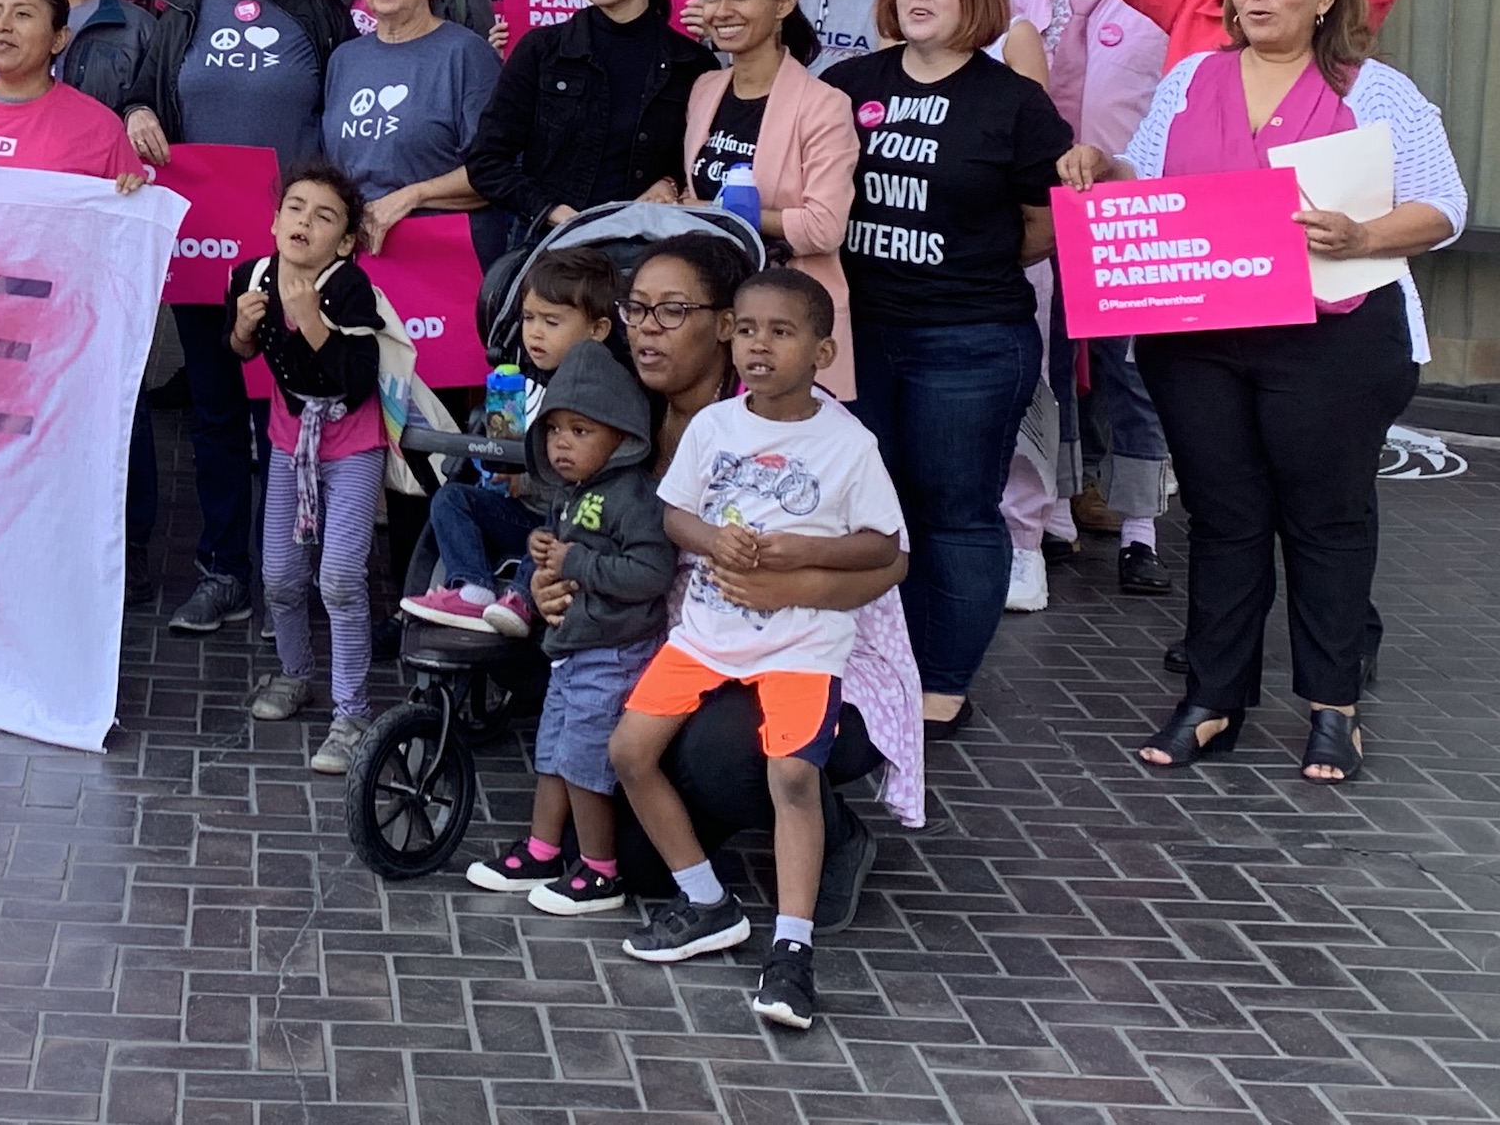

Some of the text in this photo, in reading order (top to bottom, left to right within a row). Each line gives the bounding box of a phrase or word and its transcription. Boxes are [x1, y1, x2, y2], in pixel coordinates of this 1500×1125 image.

[885, 95, 950, 125] MIND
[867, 131, 939, 164] YOUR
[864, 172, 928, 211] OWN
[1087, 193, 1186, 218] I STAND
[848, 220, 945, 265] UTERUS
[1090, 219, 1158, 241] WITH
[1092, 238, 1211, 265] PLANNED
[1095, 257, 1272, 288] PARENTHOOD
[1109, 294, 1204, 310] Planned Parenthood
